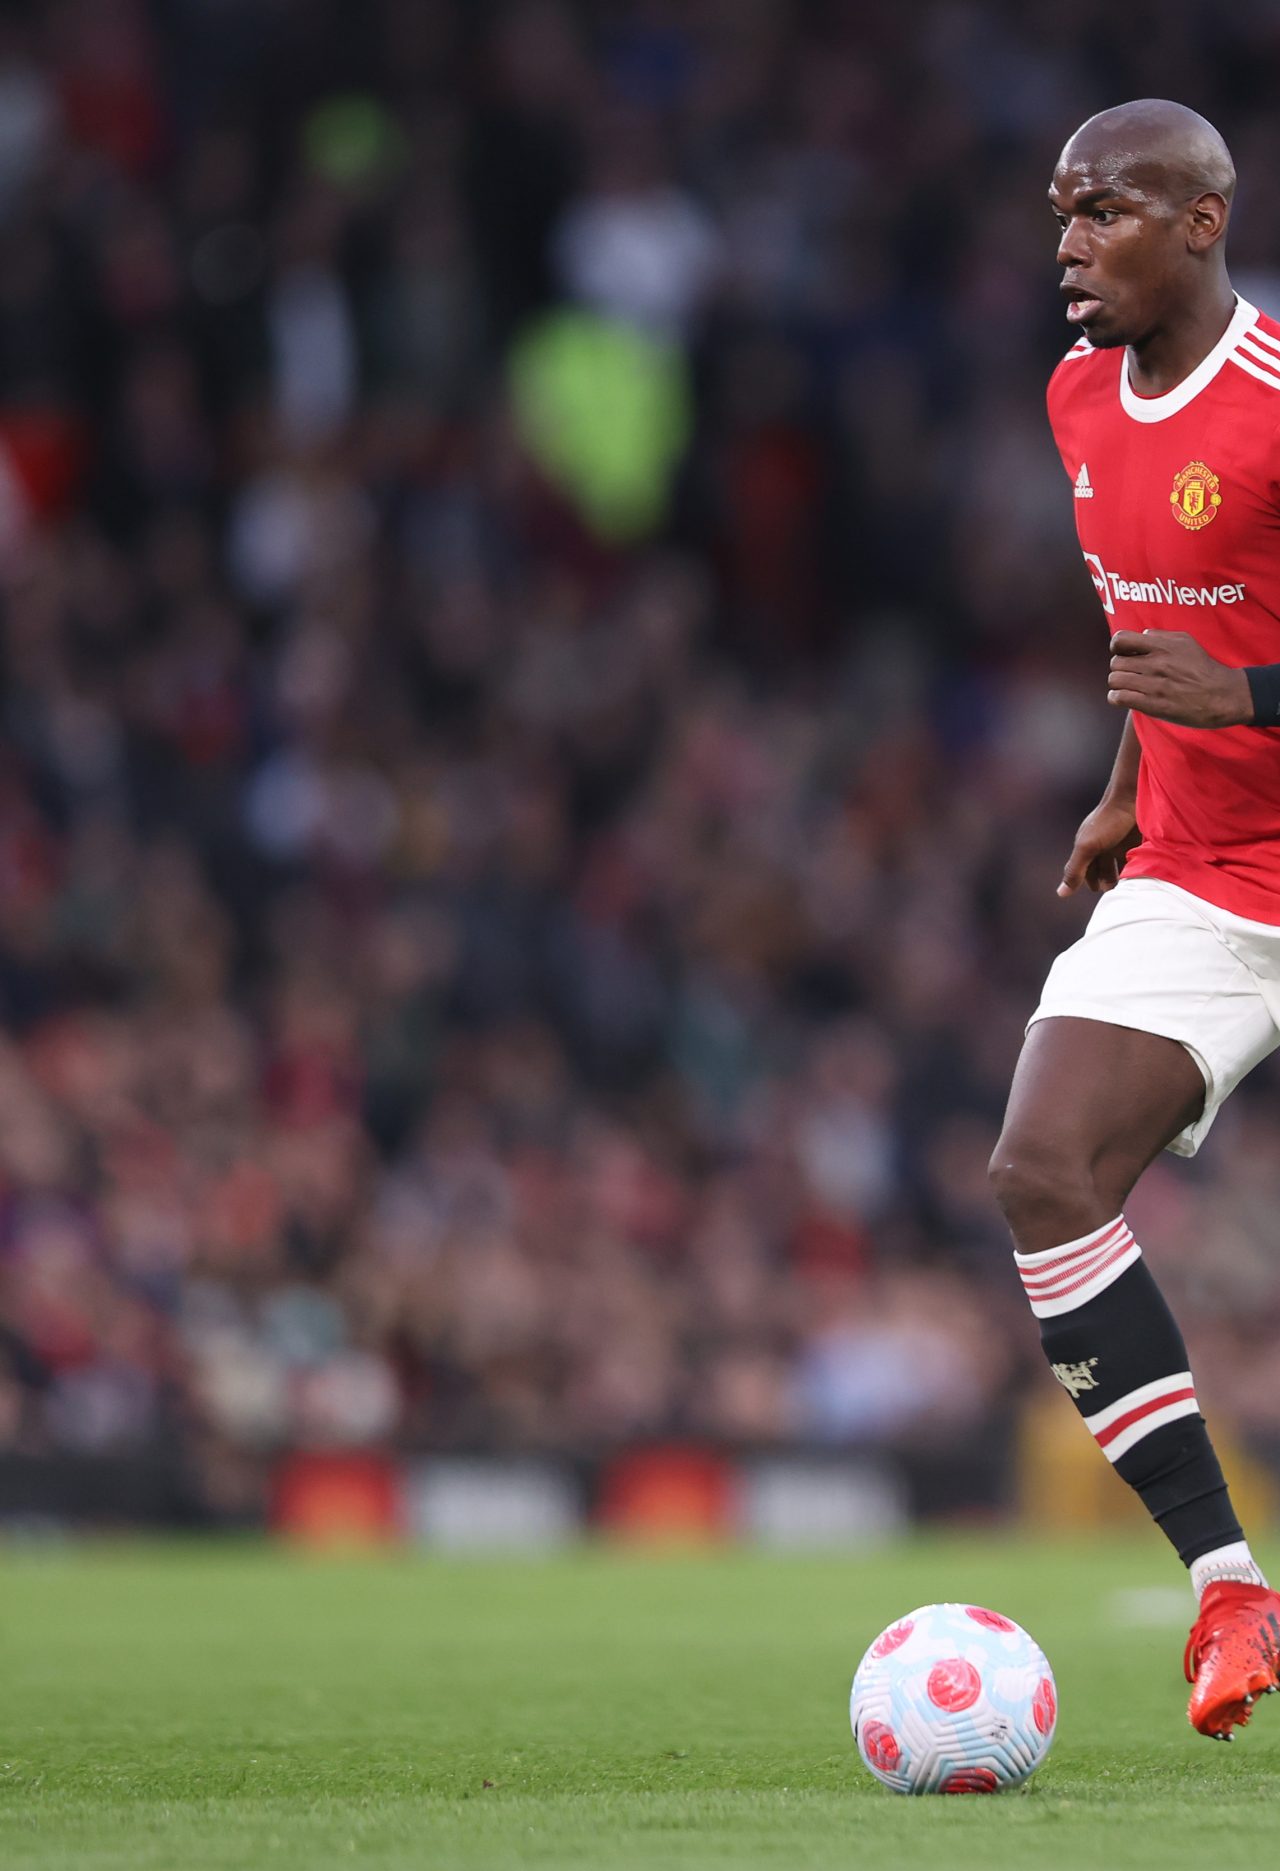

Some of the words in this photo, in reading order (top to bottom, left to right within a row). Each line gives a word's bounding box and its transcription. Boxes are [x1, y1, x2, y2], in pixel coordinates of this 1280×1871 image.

[1177, 466, 1216, 489] MANCHESTER
[1179, 513, 1209, 526] UNITED
[1106, 572, 1246, 606] TeamViewer
